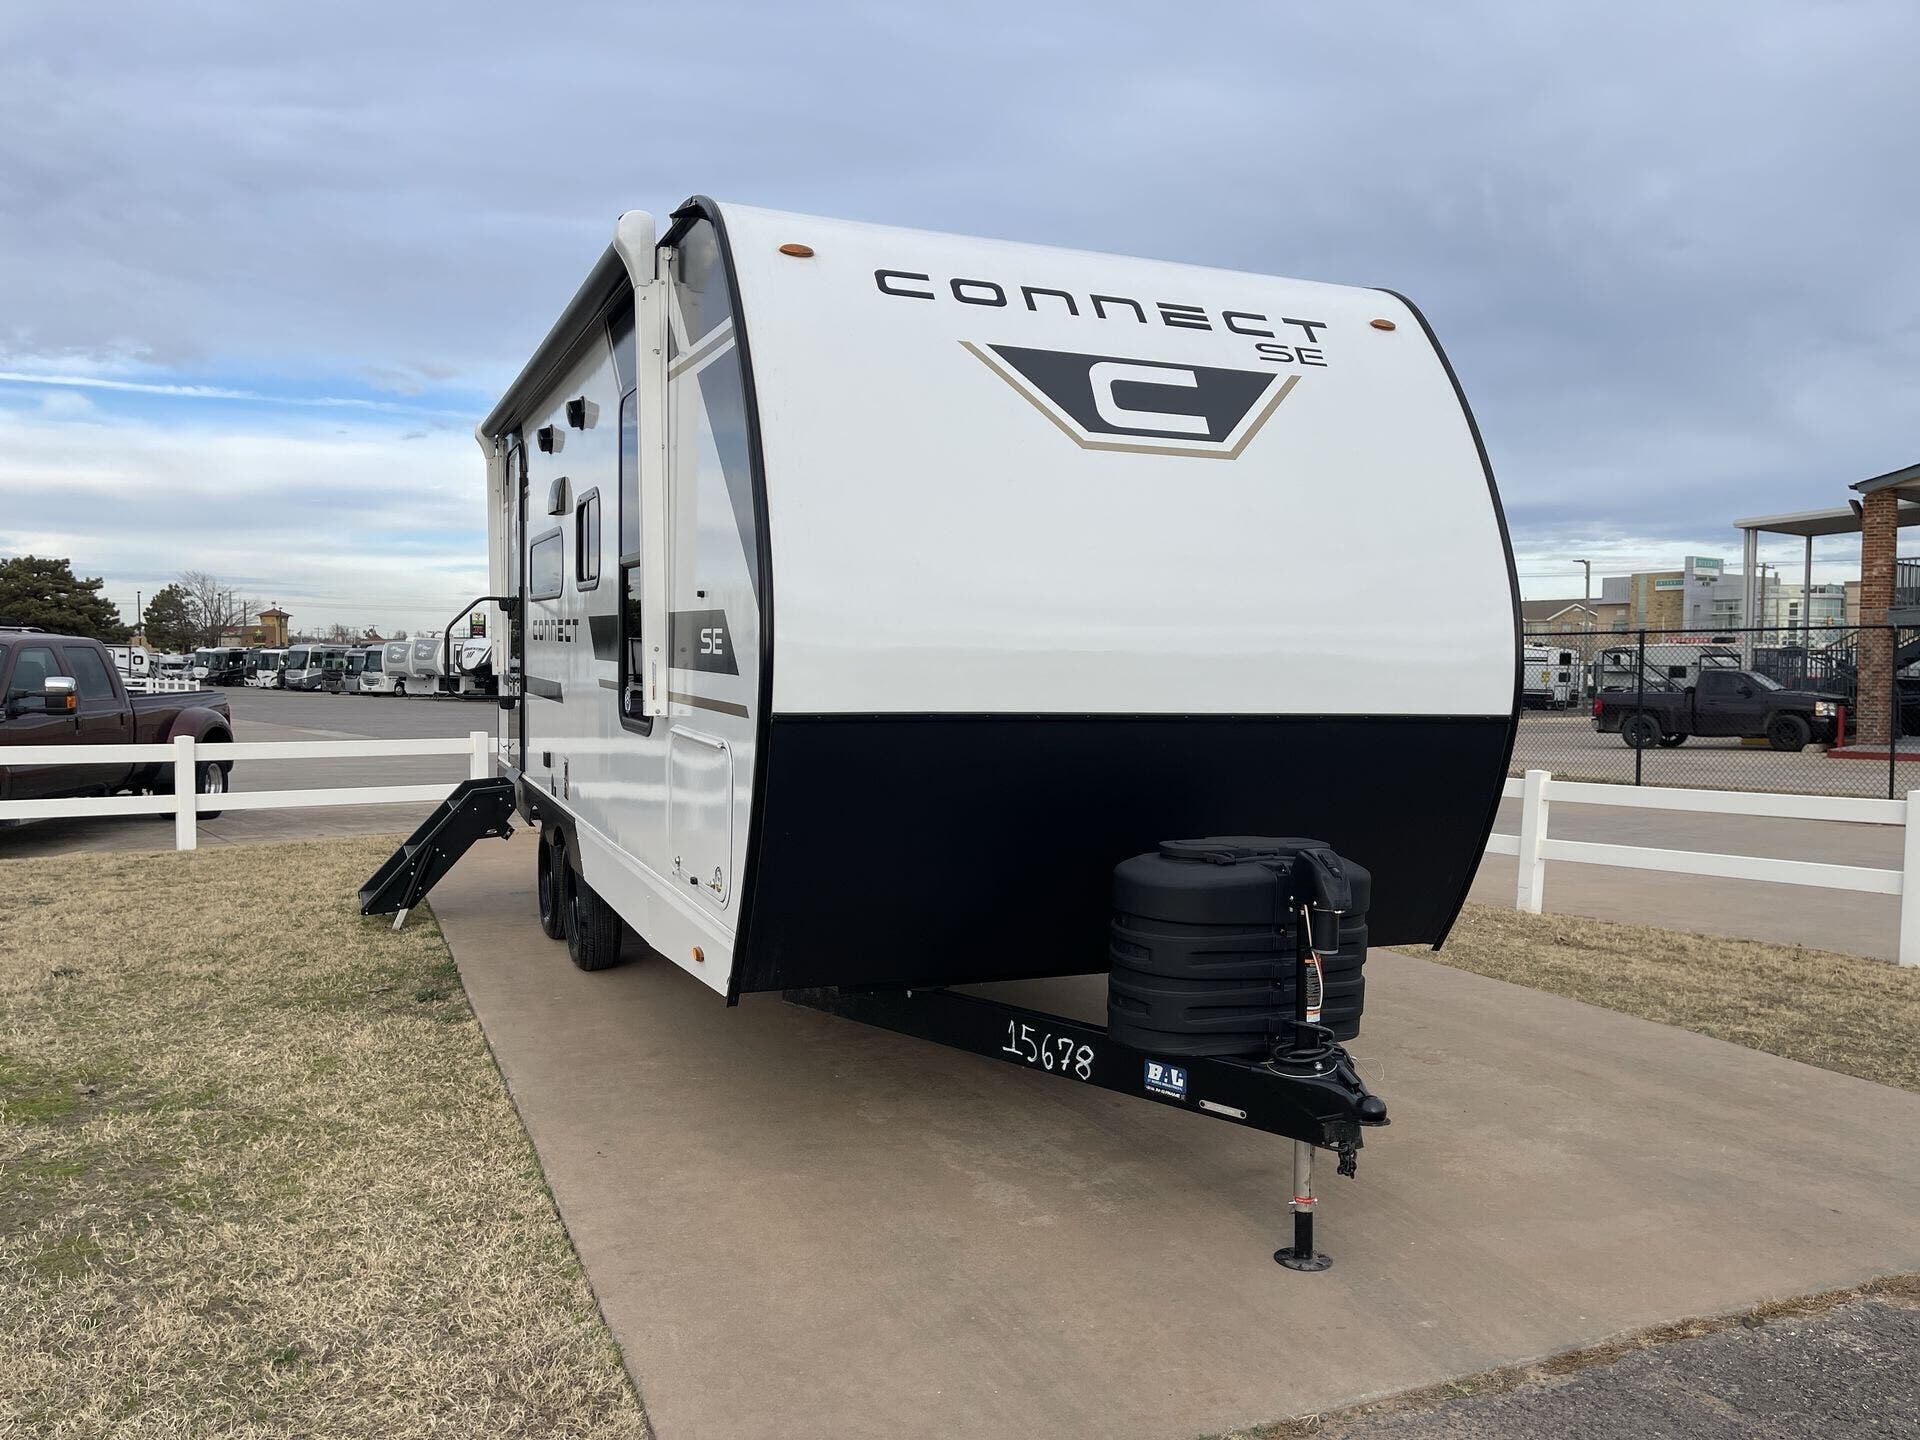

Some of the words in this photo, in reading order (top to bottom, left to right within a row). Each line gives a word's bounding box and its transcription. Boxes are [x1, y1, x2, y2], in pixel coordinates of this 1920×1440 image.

[874, 269, 1328, 343] CONNECT
[1255, 342, 1328, 367] SE
[1088, 361, 1211, 435] C
[532, 618, 579, 643] CONNECT
[700, 628, 723, 655] SE
[1002, 1019, 1095, 1081] 15678
